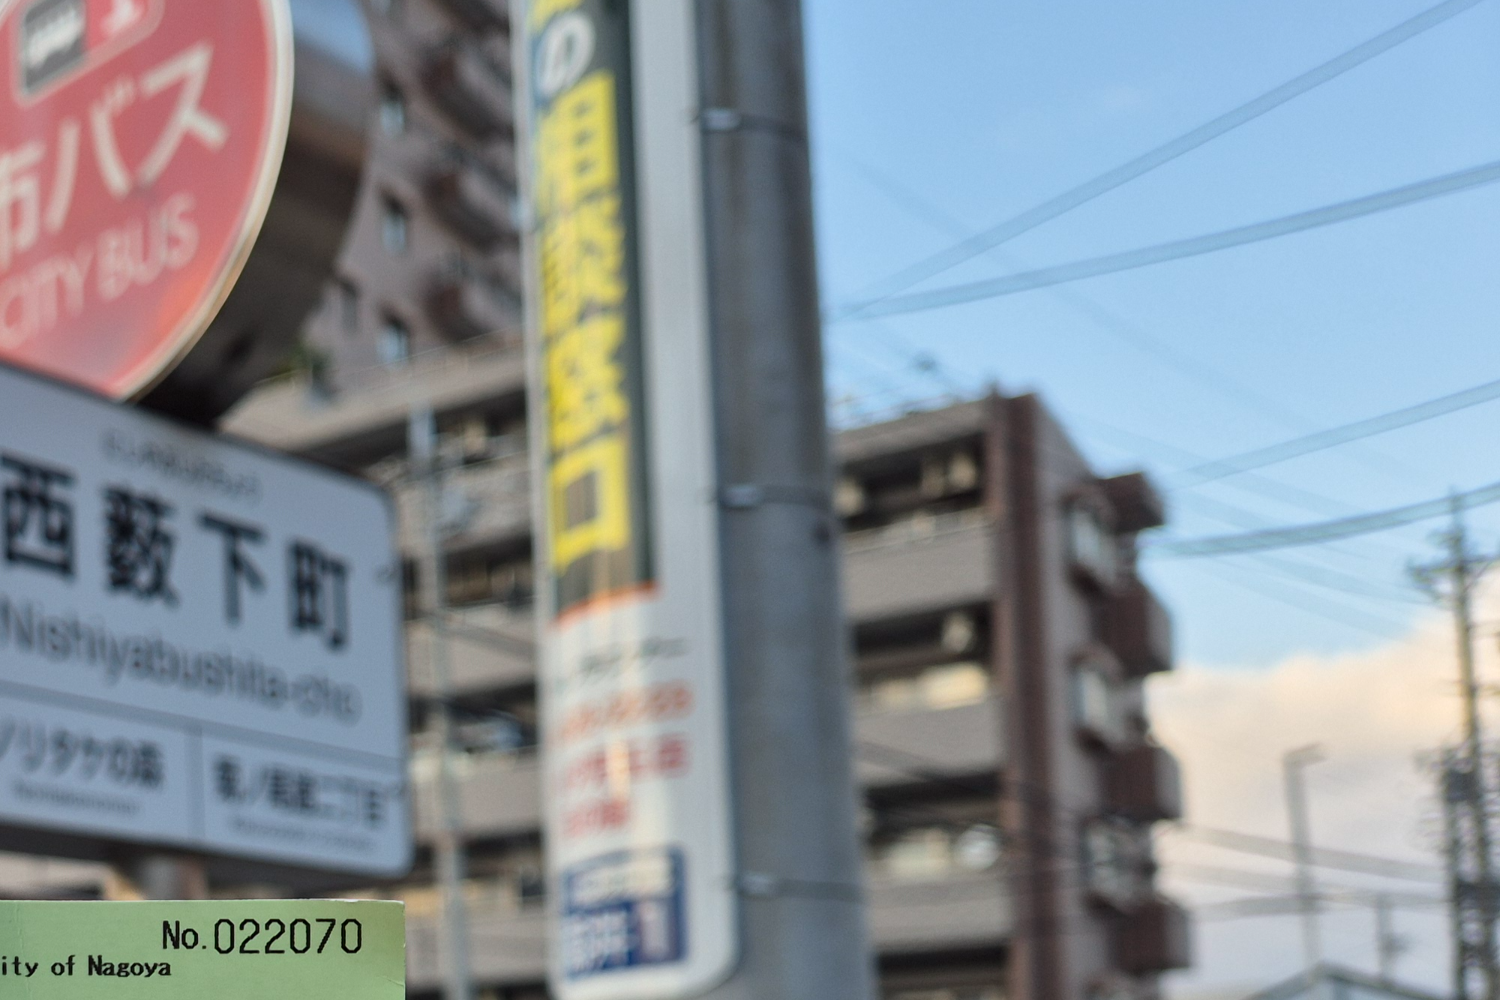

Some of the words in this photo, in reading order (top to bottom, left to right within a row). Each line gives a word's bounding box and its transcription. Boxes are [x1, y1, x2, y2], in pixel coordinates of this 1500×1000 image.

[99, 194, 199, 304] BUS
[162, 918, 363, 955] No.022070
[51, 955, 76, 977] of
[88, 955, 172, 979] Nagoya
